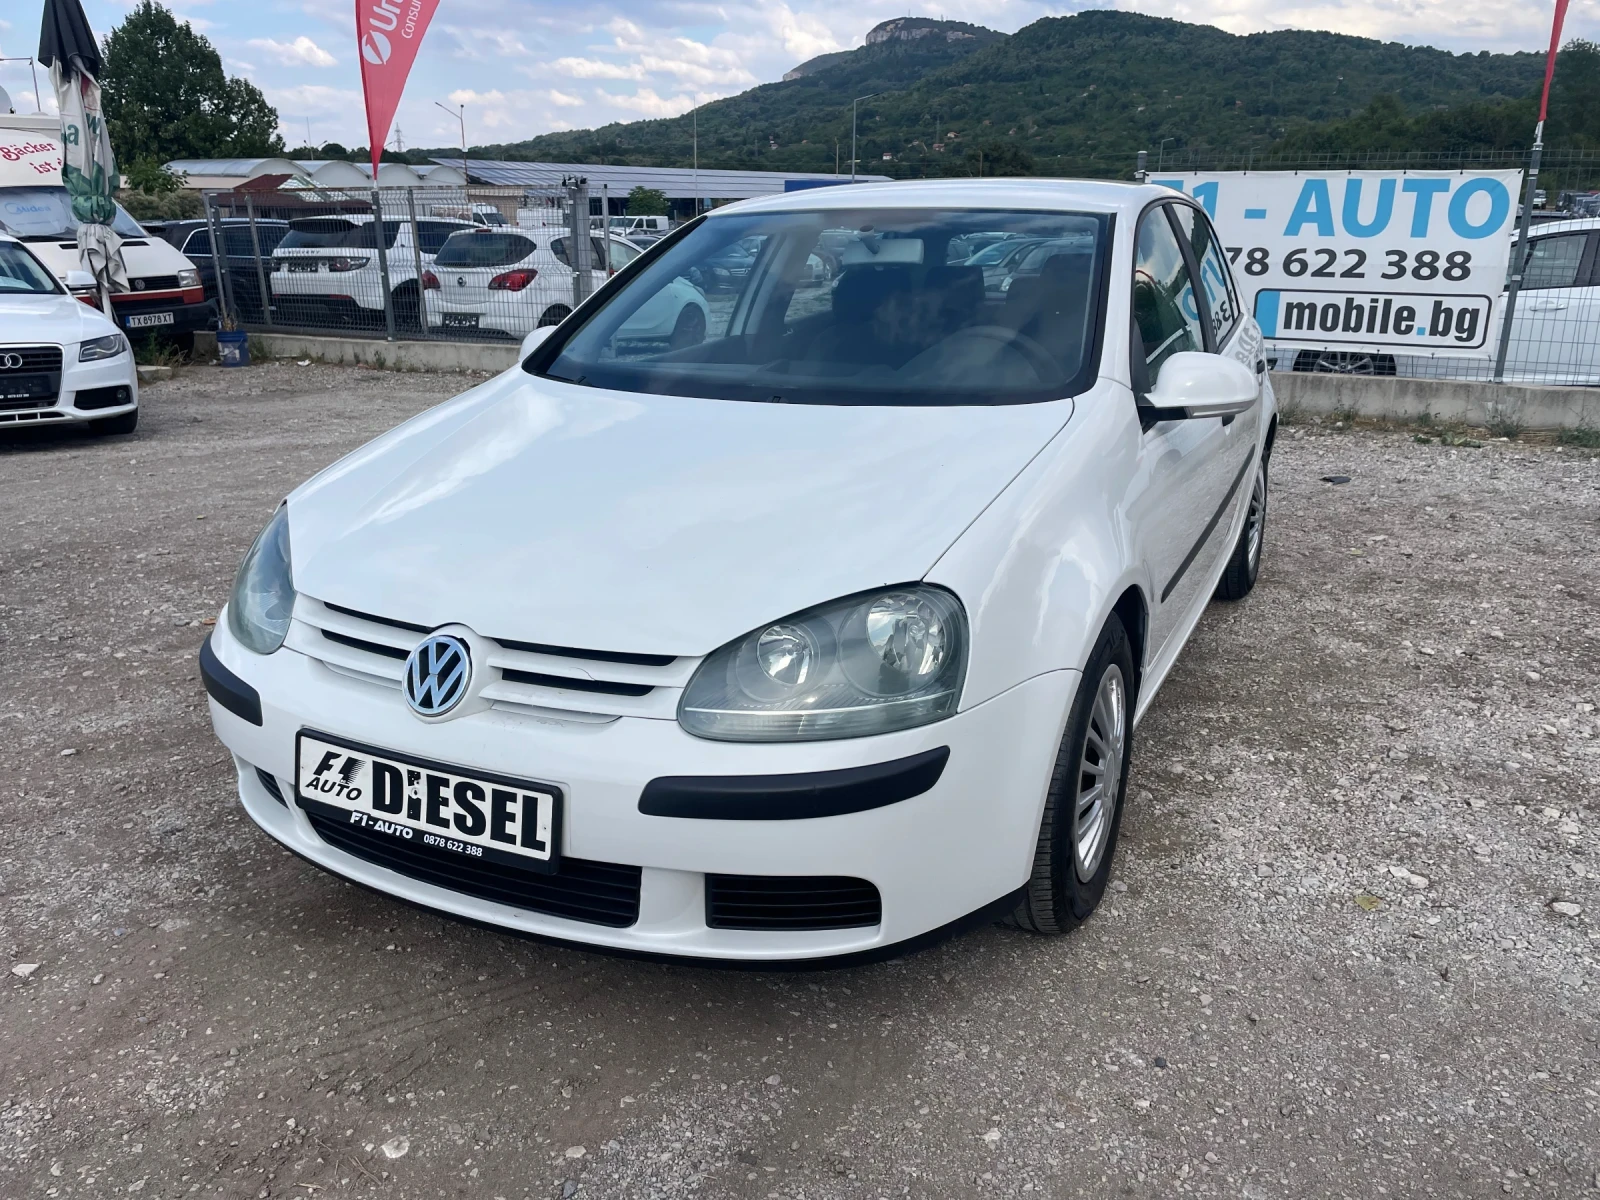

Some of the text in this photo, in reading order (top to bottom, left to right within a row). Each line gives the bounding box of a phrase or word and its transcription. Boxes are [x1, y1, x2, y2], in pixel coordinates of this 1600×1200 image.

[401, 0, 422, 39] Consu
[0, 142, 57, 161] Bäcker
[1283, 177, 1510, 240] AUTO
[1282, 248, 1367, 279] 622
[1381, 250, 1472, 282] 388
[1284, 297, 1480, 342] mobile.bg
[305, 777, 362, 801] AUTO
[423, 834, 445, 848] 0878
[447, 840, 463, 852] 622
[465, 846, 483, 857] 388
